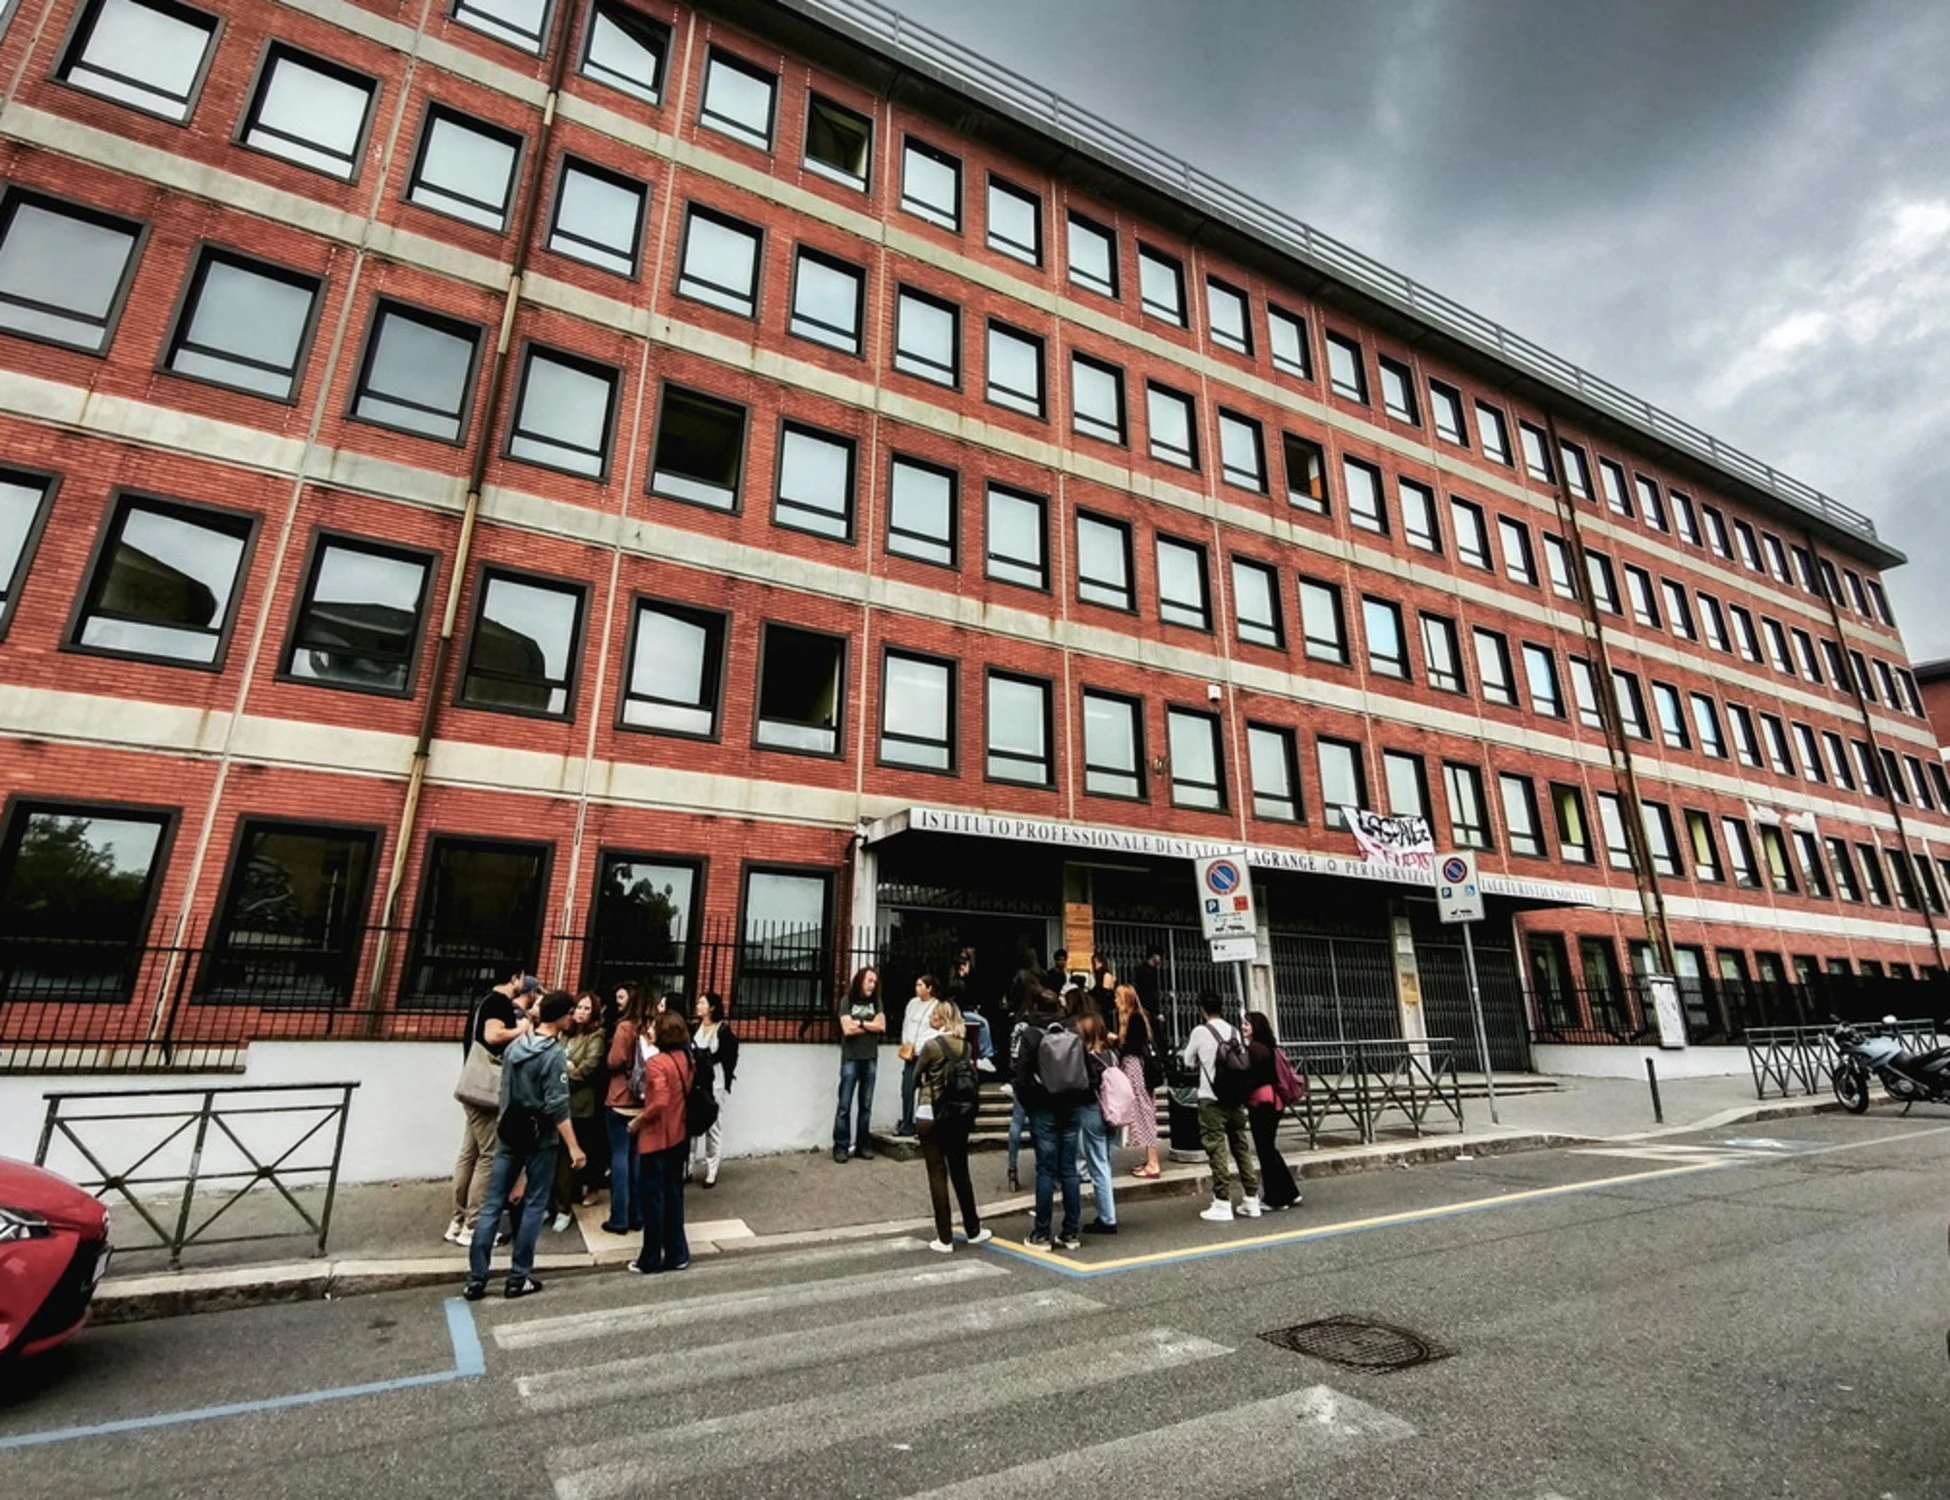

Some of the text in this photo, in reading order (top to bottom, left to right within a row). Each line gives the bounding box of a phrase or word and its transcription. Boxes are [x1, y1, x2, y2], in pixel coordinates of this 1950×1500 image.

[922, 811, 1009, 835] ISTITUTO
[1016, 821, 1150, 851] PROFESSIONALE
[1247, 851, 1316, 869] AGRANGE
